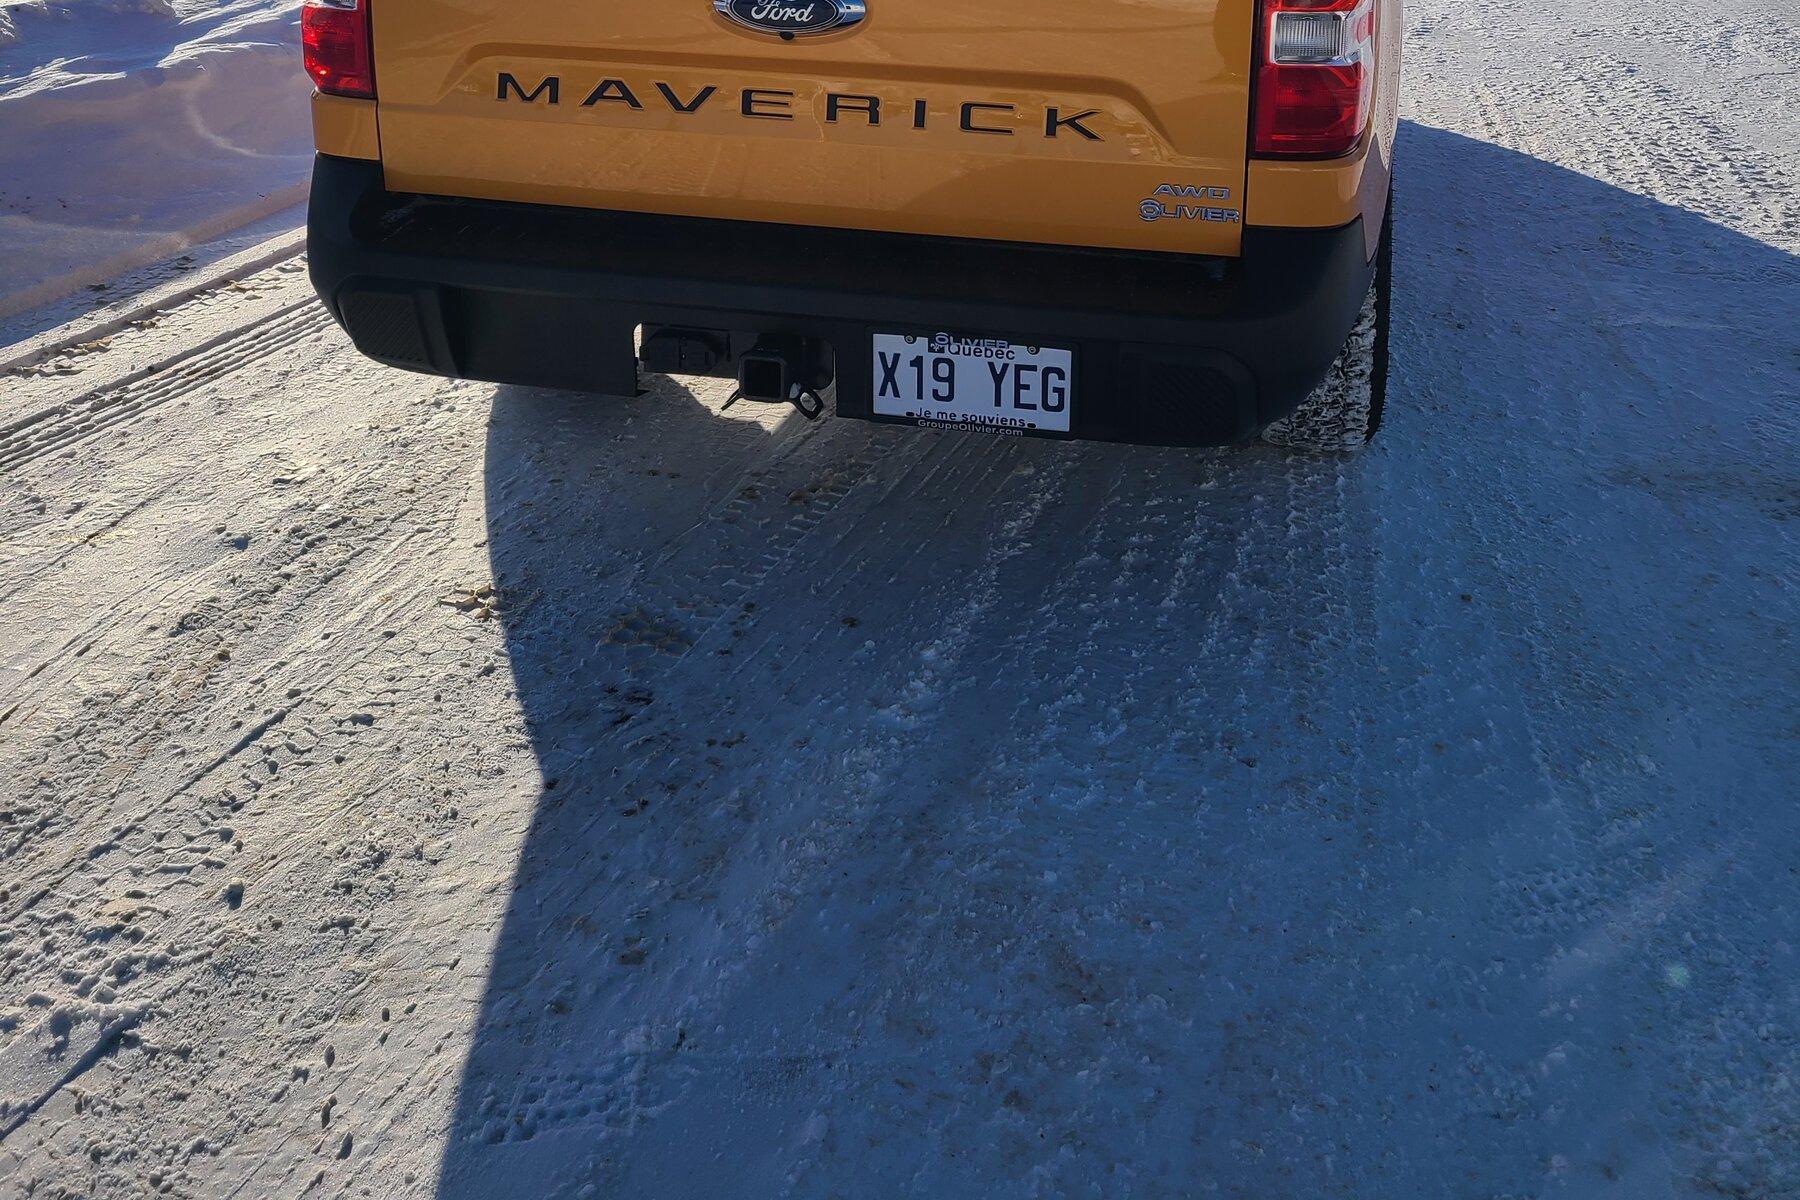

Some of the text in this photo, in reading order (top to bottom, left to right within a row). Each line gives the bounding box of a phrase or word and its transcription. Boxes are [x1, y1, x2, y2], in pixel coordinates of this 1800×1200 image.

[498, 73, 1103, 142] MAVERICK
[1153, 183, 1230, 200] AWD
[1139, 198, 1240, 223] OLIVIER
[935, 332, 1010, 349] OLIVIER
[878, 351, 1066, 413] X19 YEG
[916, 407, 1026, 428] Je me souviens
[917, 419, 1024, 436] GroupeOlivier.com
